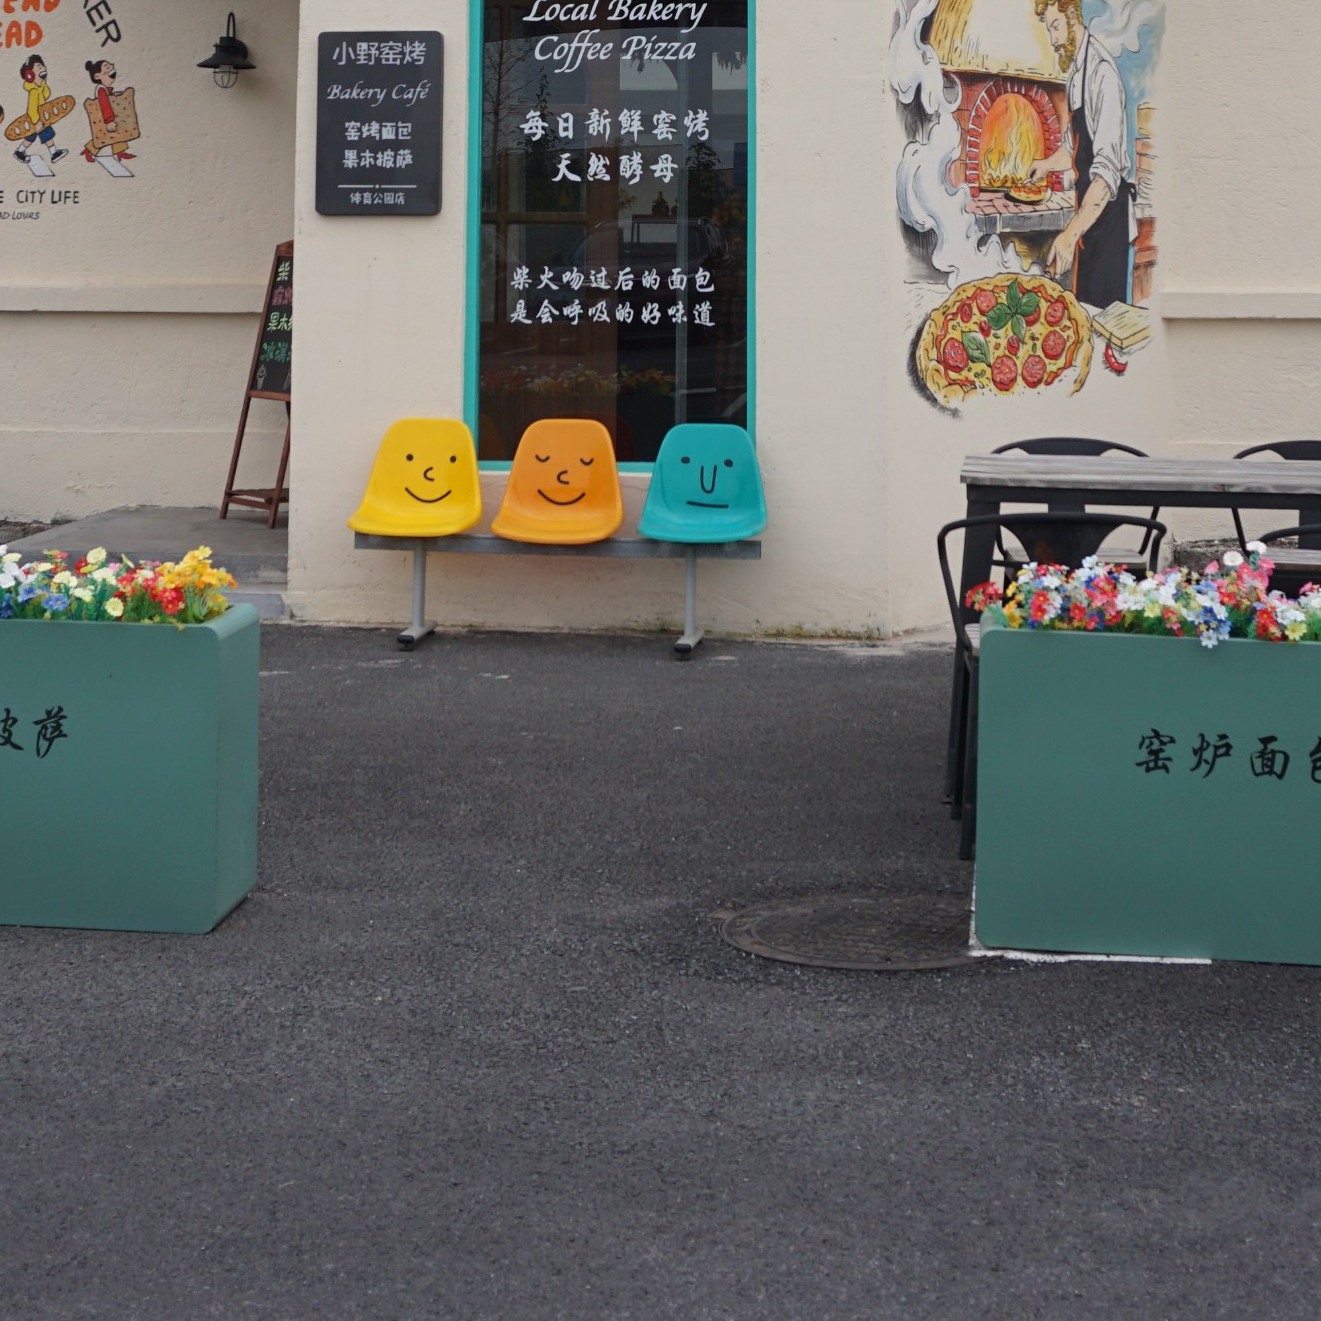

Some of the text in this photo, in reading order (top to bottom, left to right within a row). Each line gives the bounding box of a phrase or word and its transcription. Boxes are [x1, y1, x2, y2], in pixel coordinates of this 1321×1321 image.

[332, 40, 427, 66] 小野窑烤
[534, 29, 696, 73] Coffee Pizza
[326, 80, 386, 107] Bakery
[344, 120, 412, 141] 窑烤面包
[519, 108, 711, 142] 每日新鲜窑烤
[342, 148, 413, 169] 果木披萨
[551, 152, 679, 185] 天然酵母
[50, 189, 80, 205] LIFE
[349, 191, 406, 205] 体育公园店
[510, 266, 715, 293] 柴火吻过后的面包
[510, 299, 716, 327] 是会呼吸的好味道
